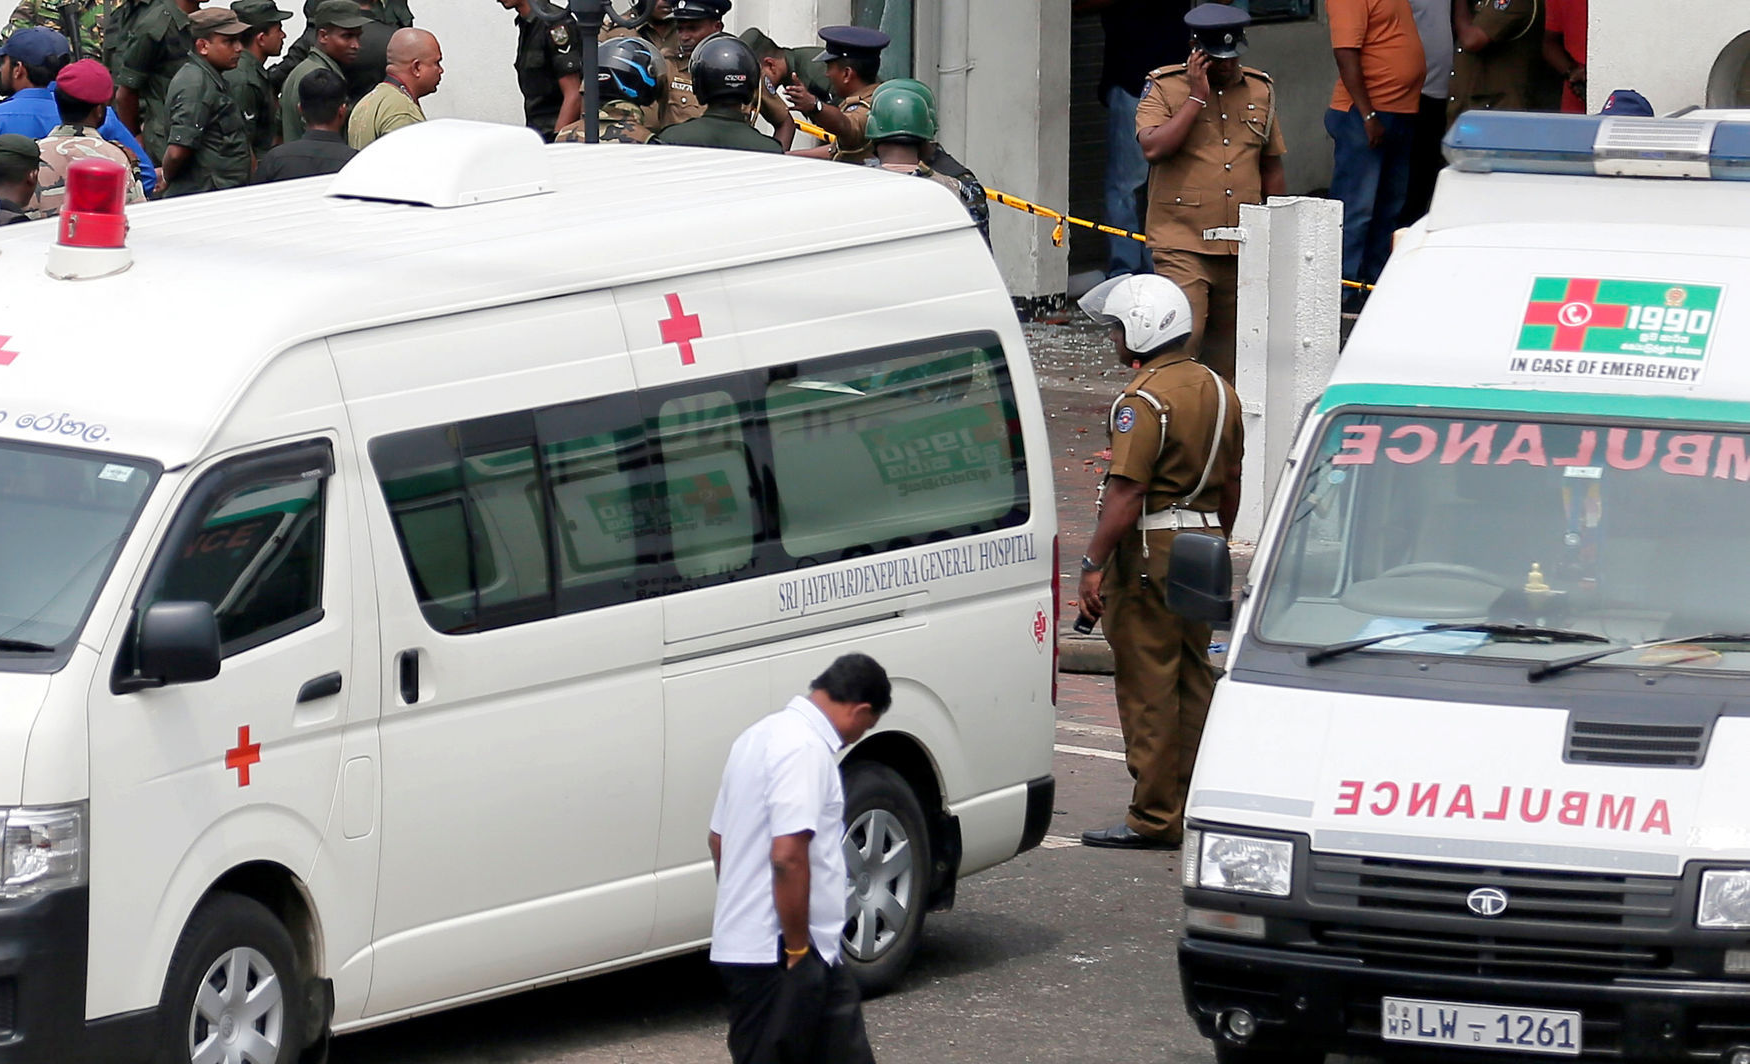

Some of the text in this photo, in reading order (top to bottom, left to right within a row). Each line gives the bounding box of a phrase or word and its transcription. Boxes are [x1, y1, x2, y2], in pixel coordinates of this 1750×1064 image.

[1627, 305, 1713, 334] 1990
[1510, 357, 1701, 382] IN CASE OF EMERGENCY
[779, 581, 798, 612] SRI
[800, 556, 920, 615] JAYEWARDENEPURA
[920, 545, 975, 582] GENERAL
[979, 533, 1037, 570] HOSPITAL
[1496, 1013, 1575, 1048] 1261
